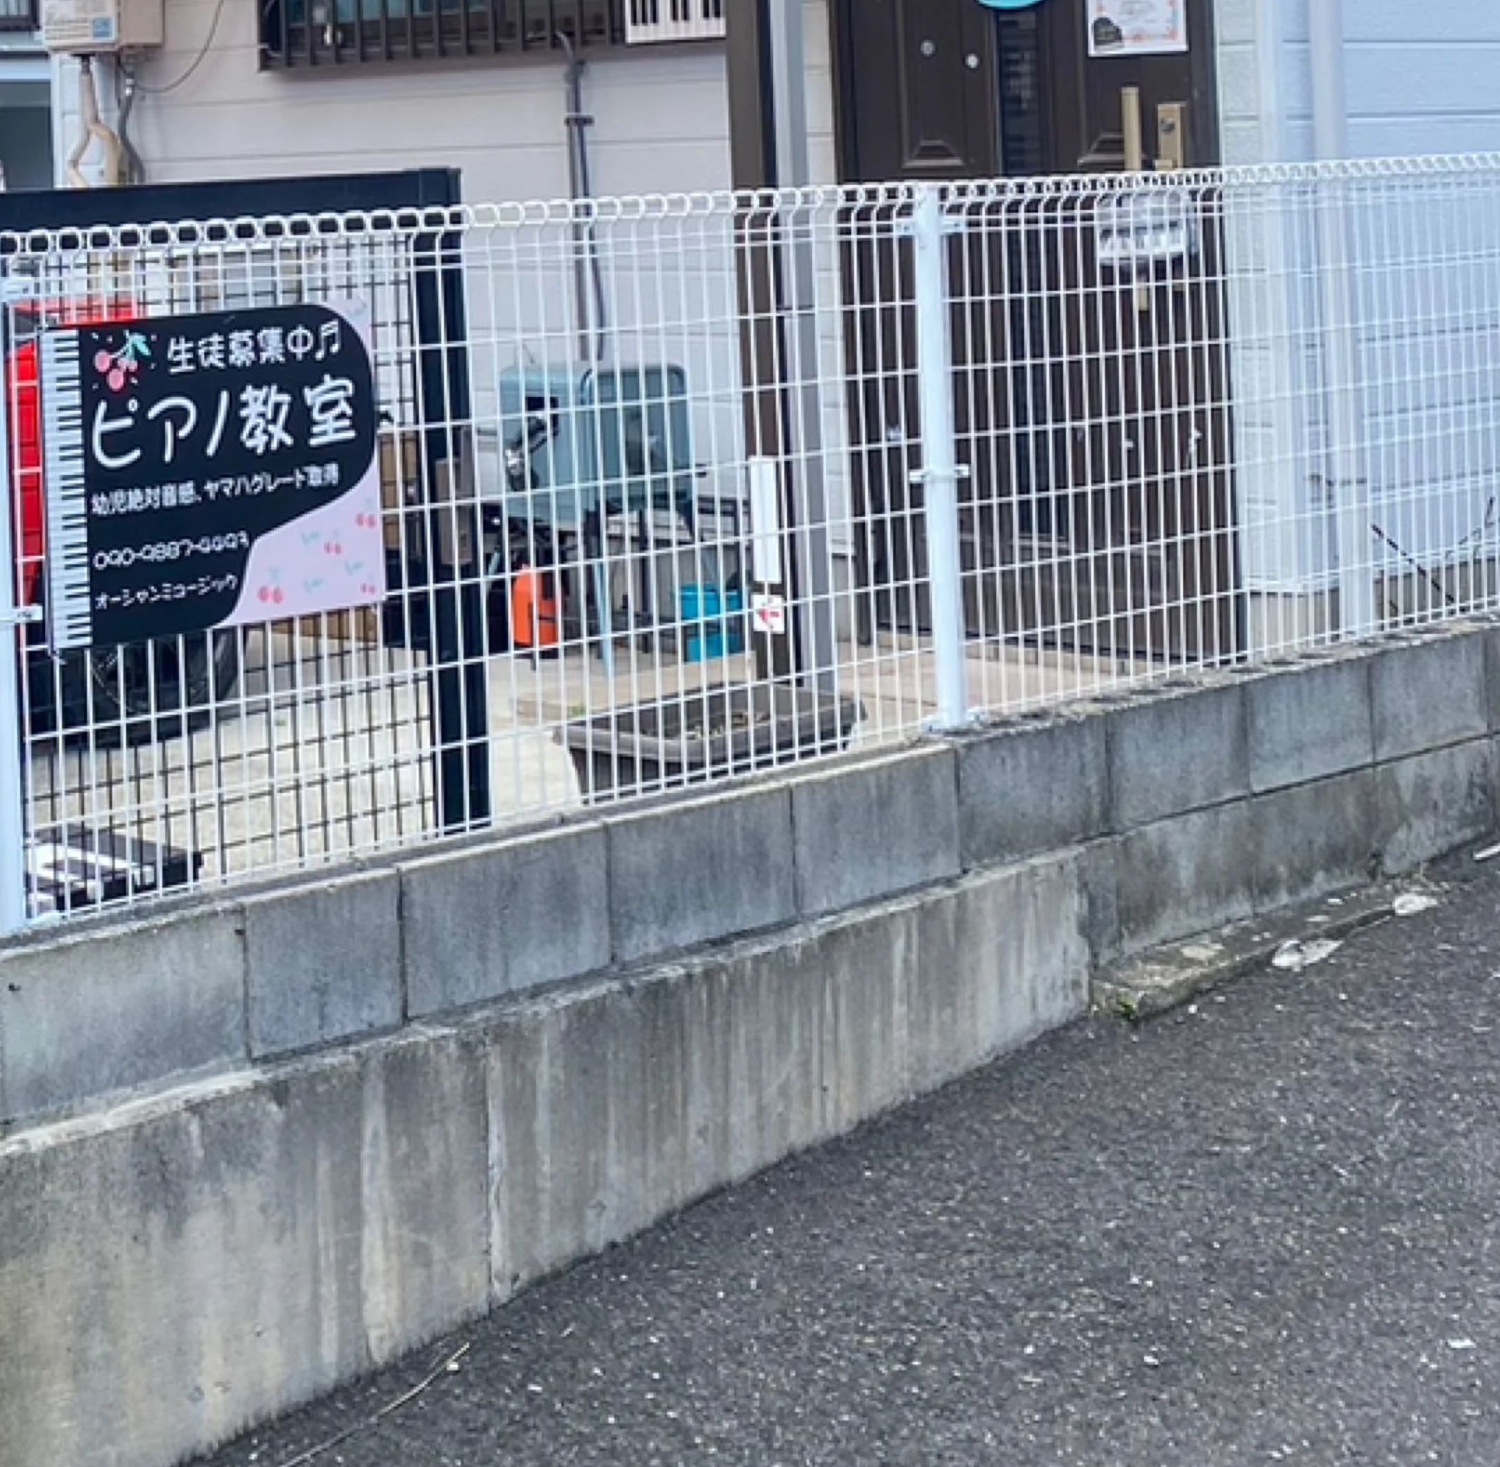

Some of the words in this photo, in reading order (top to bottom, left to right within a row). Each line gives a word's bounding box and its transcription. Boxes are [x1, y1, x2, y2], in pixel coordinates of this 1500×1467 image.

[93, 374, 356, 468] ピアノ教室
[95, 574, 237, 610] オーシャンミュージック
